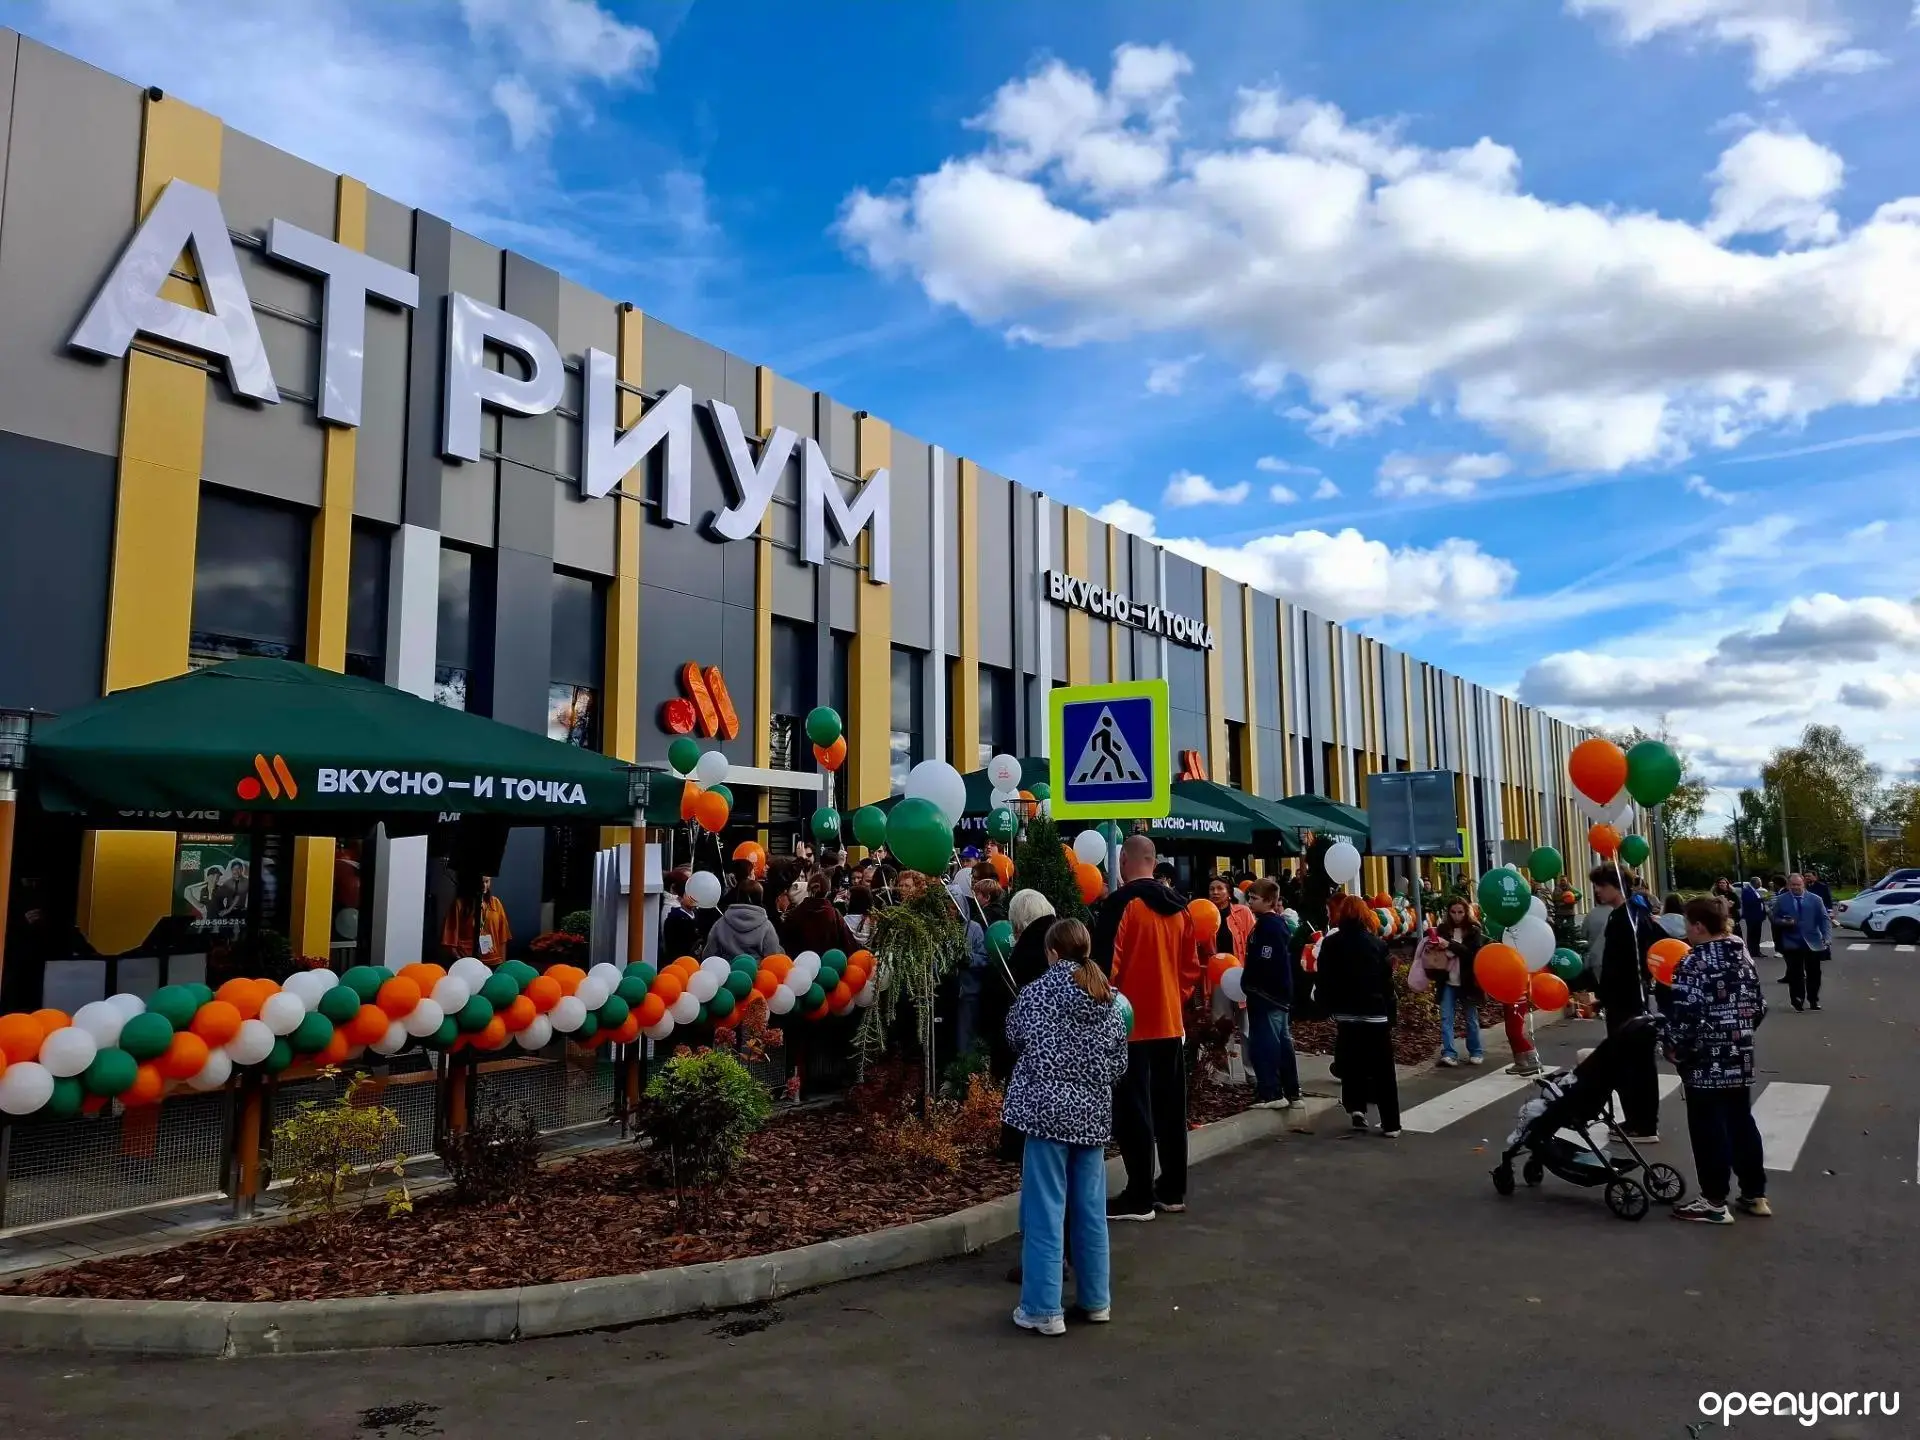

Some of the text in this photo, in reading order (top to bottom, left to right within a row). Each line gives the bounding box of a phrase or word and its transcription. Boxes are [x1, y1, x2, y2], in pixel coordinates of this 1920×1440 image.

[67, 177, 891, 584] АТРИУМ
[1050, 570, 1130, 622] ВКУСНО
[1163, 610, 1216, 650] ТОЧКА
[317, 768, 444, 796] ВКУСНО
[501, 777, 587, 805] ТОЧКА
[1200, 820, 1225, 833] ТОЧКА
